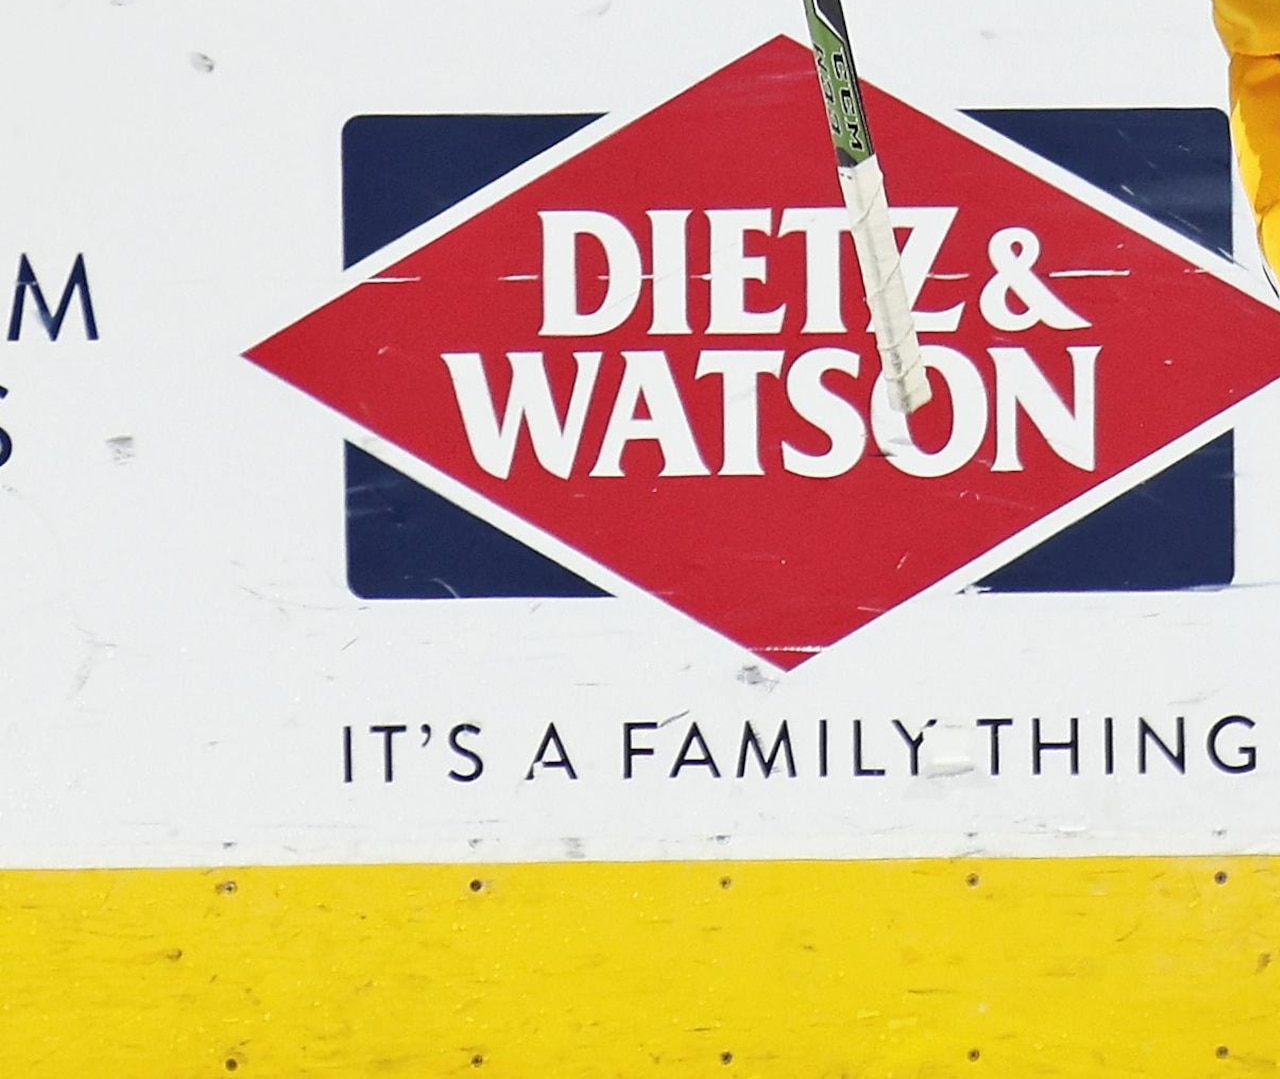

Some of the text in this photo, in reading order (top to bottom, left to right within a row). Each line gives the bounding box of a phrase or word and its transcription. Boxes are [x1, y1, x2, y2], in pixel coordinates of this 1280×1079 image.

[831, 47, 863, 153] CCM
[538, 205, 1093, 338] DIETZ &
[441, 345, 1102, 482] WATSON
[342, 713, 1259, 784] IT'S A FAMILY THING
